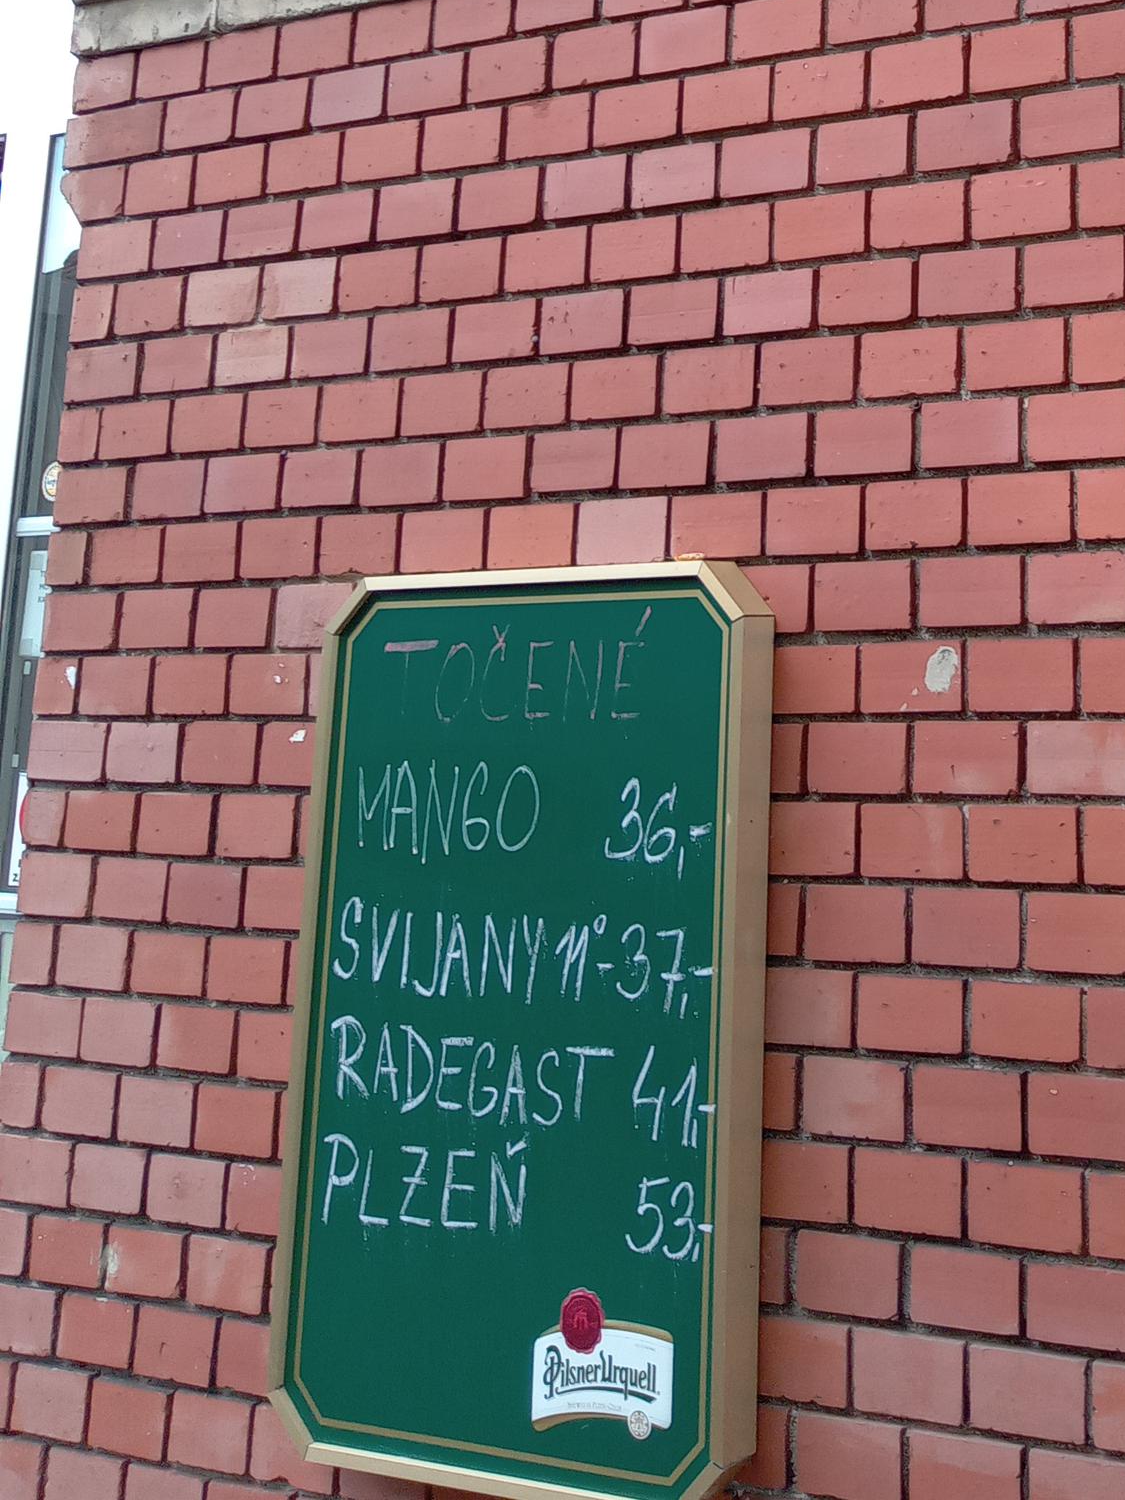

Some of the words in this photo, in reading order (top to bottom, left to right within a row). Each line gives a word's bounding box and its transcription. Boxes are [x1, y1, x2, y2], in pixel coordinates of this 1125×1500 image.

[384, 606, 652, 723] TOČENÉ
[357, 759, 541, 865] MANGO
[332, 896, 548, 1005] SVIJANY
[331, 1015, 615, 1127] RADEGAST
[543, 1345, 601, 1399] Pilsner
[599, 1349, 657, 1401] Urquell
